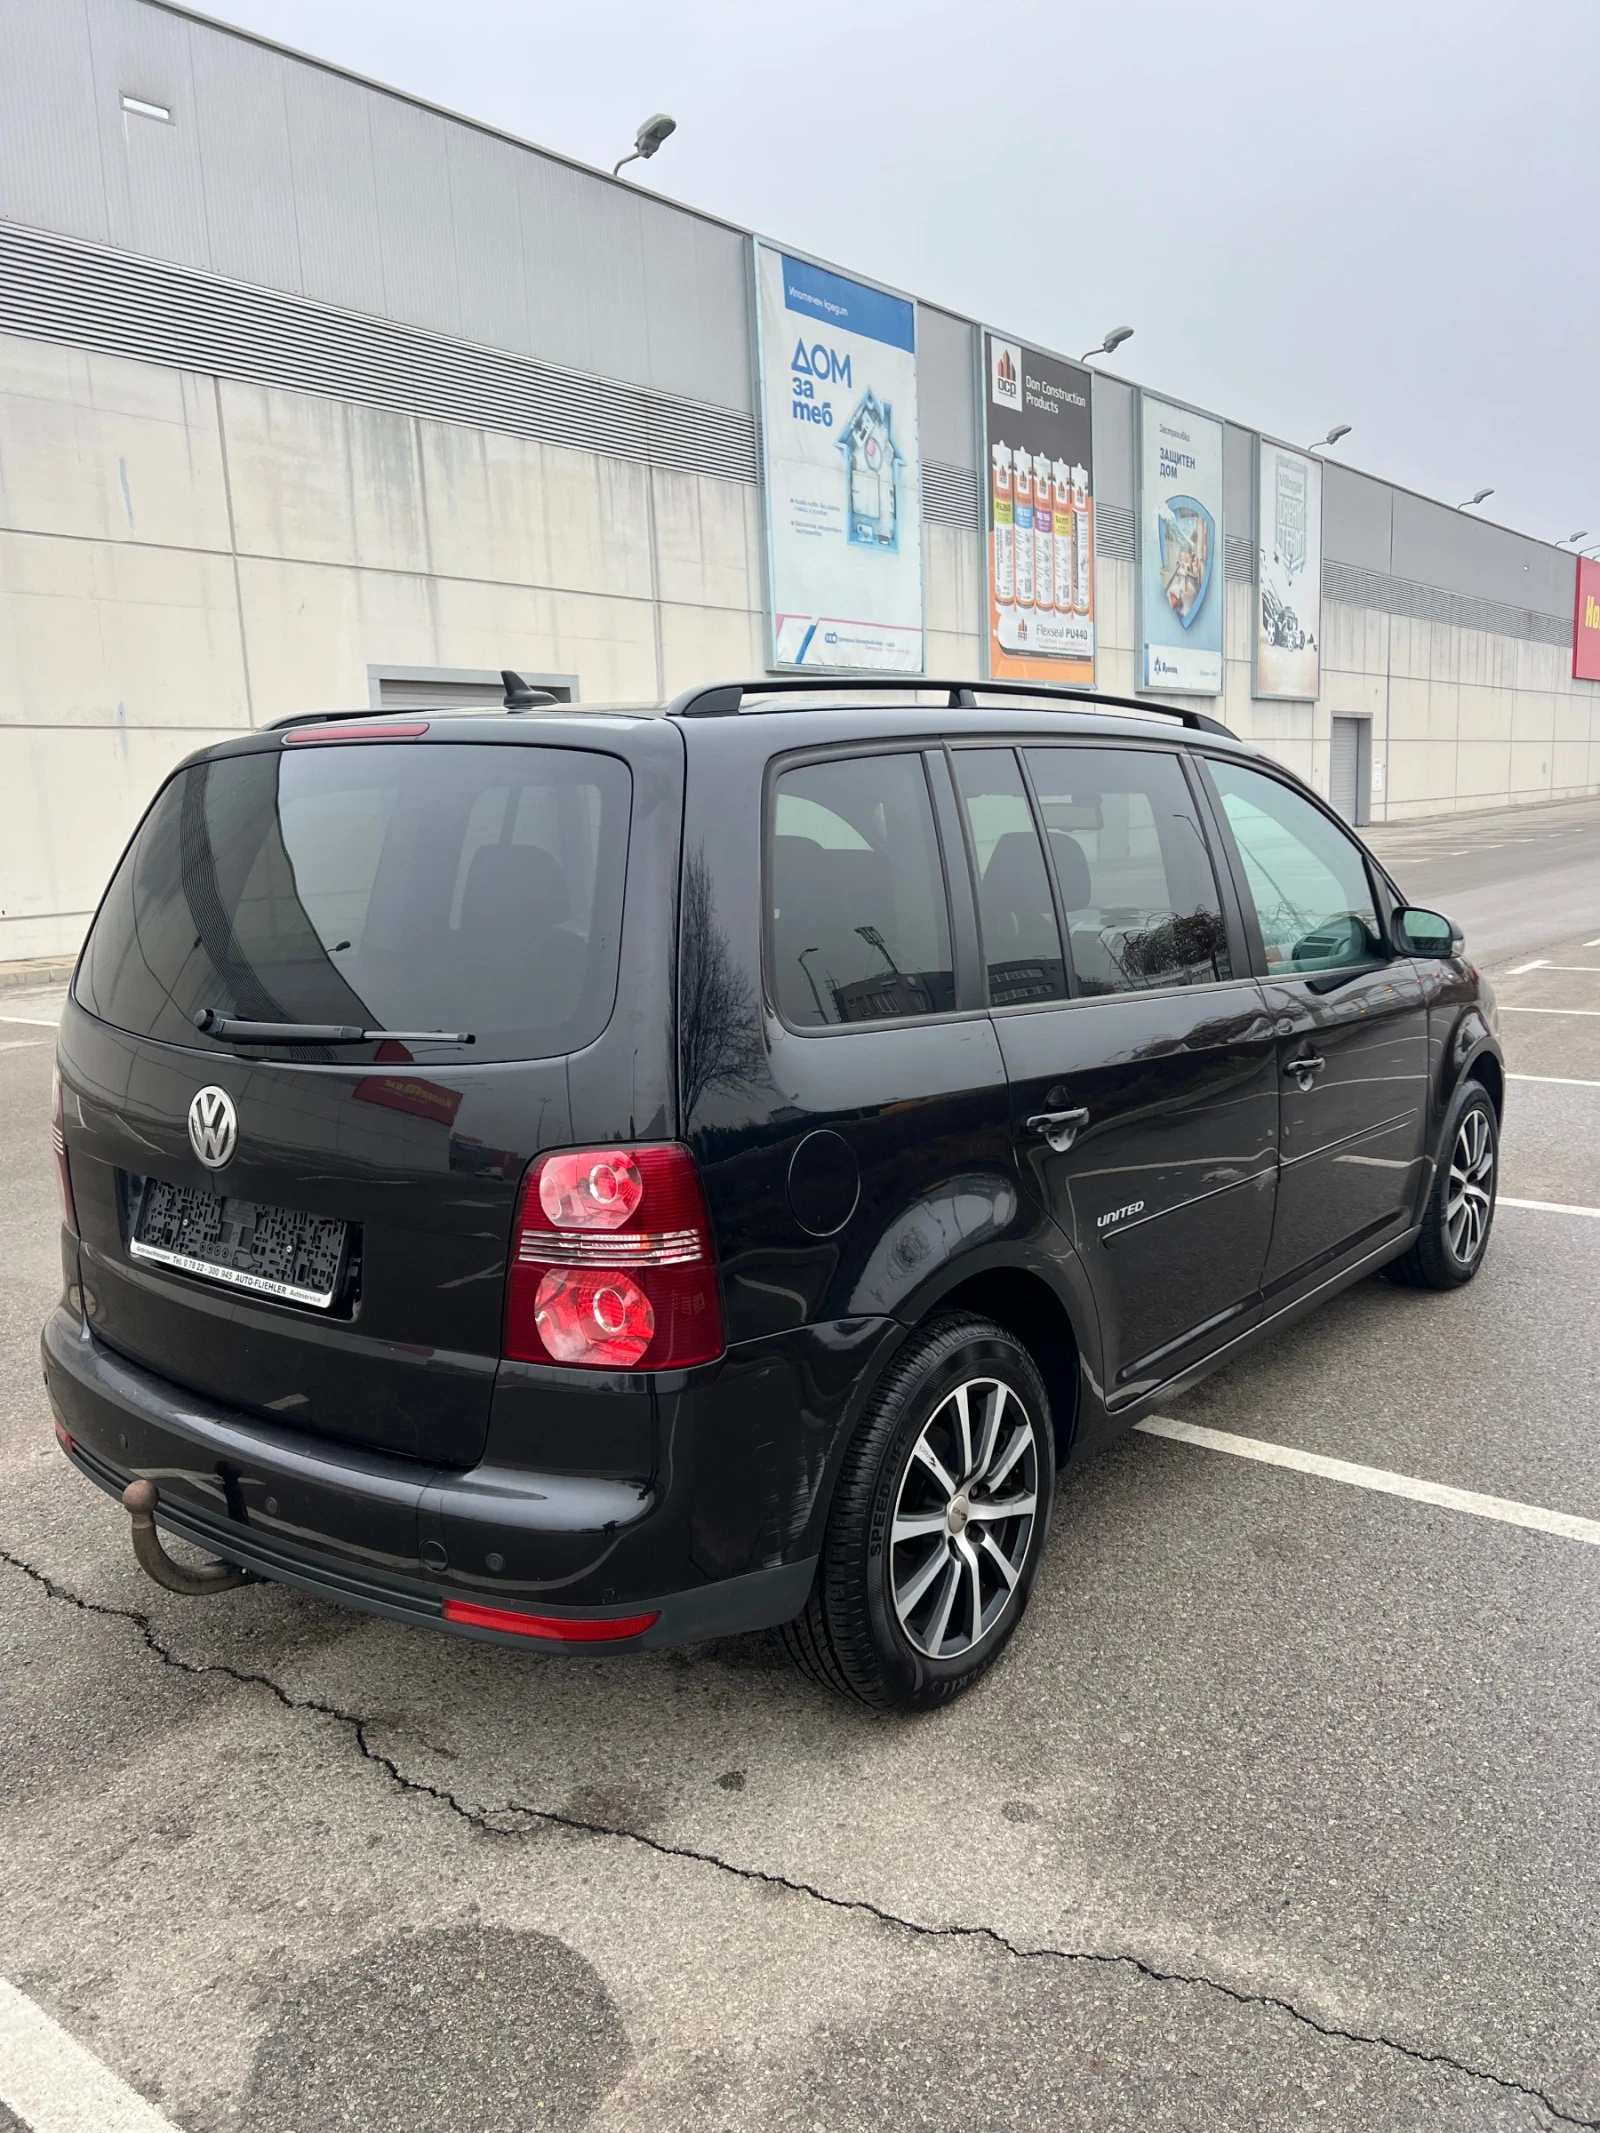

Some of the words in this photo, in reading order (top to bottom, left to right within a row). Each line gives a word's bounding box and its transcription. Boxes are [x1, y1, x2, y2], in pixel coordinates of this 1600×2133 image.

[791, 337, 852, 389] ДОМ
[792, 377, 815, 399] за
[1026, 375, 1041, 391] Don
[1041, 381, 1086, 408] Construction
[792, 400, 833, 427] теб
[1026, 391, 1059, 414] Products
[1159, 423, 1190, 443] Застраховка
[1160, 447, 1195, 470] ЗАЩИТЕН
[1160, 462, 1178, 479] ДОМ
[1036, 624, 1064, 637] Flexseal
[1065, 628, 1088, 640] PU440
[1097, 1200, 1144, 1227] UNITED
[172, 1255, 182, 1265] Tel.
[189, 1260, 196, 1269] 78
[197, 1262, 204, 1272] 22
[208, 1266, 219, 1276] 300
[221, 1269, 233, 1280] 945
[235, 1274, 287, 1295] AUTO-FLIEHLER
[290, 1289, 321, 1303] Autoservice
[870, 1432, 907, 1557] SPEED-LIFE
